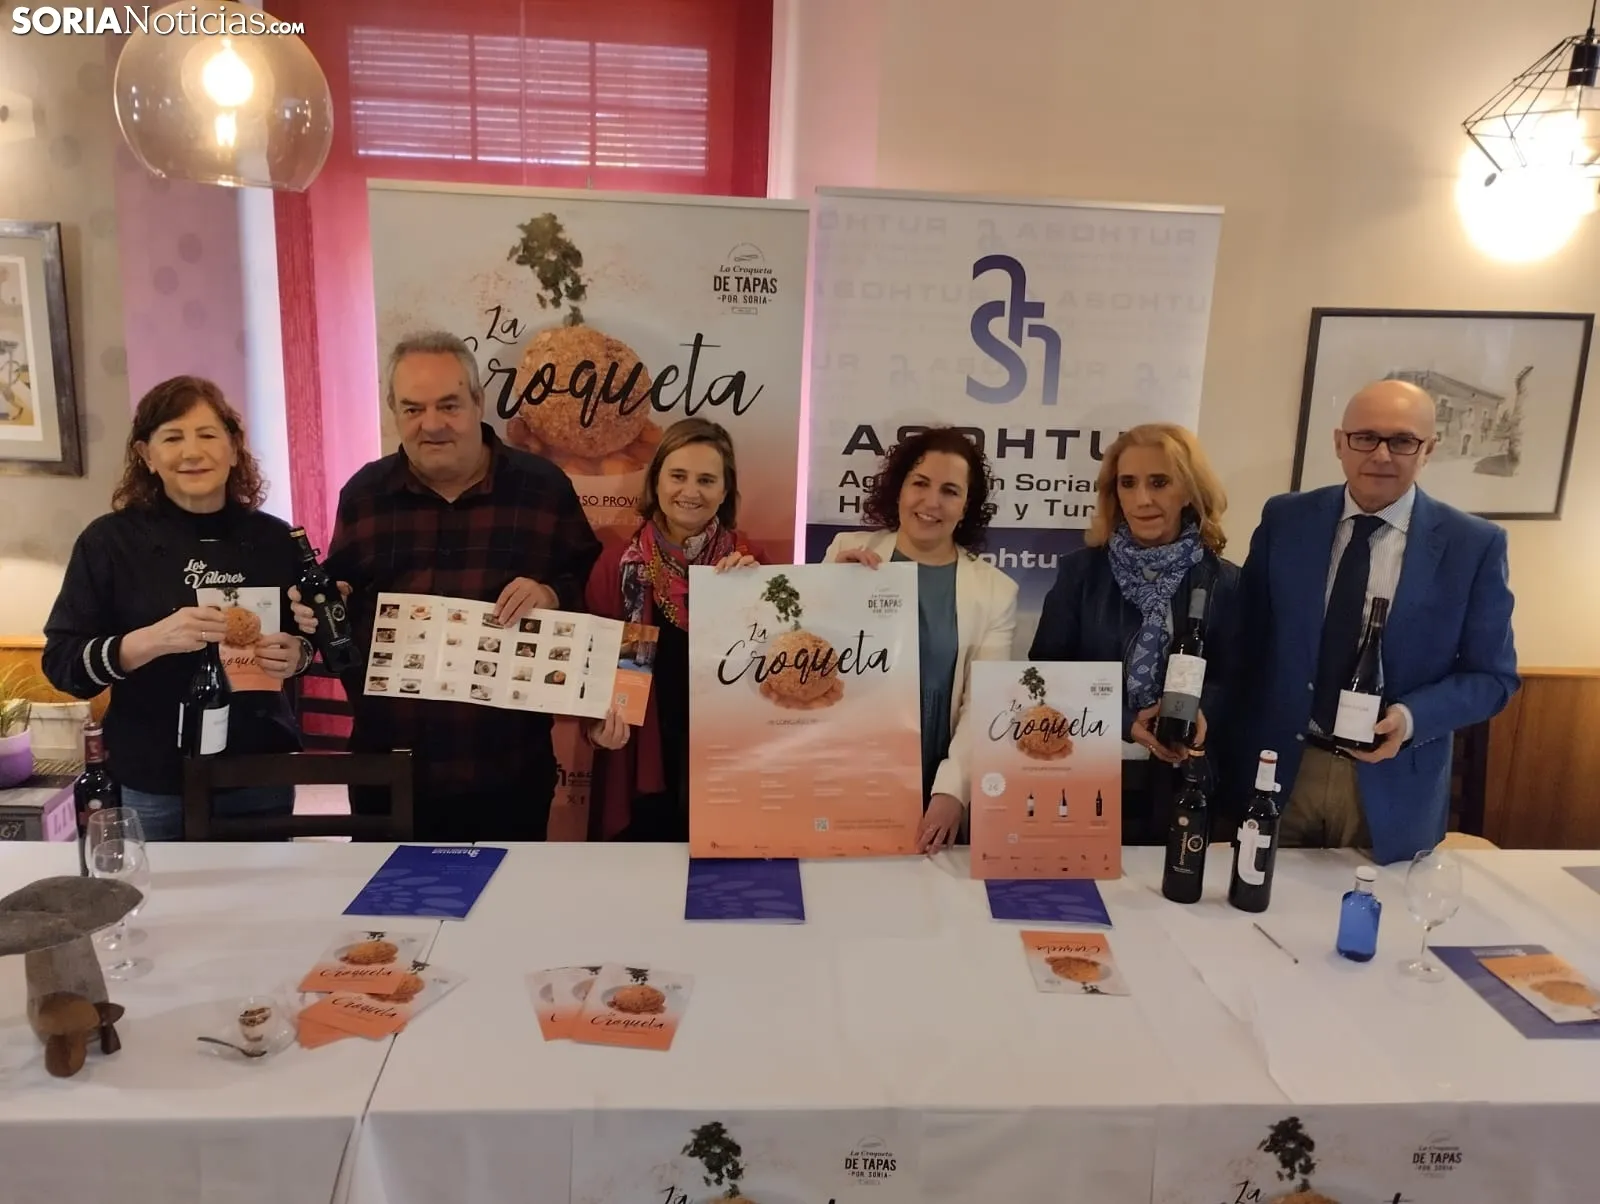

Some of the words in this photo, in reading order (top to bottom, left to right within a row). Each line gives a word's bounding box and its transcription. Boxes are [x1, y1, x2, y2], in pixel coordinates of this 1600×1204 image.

[713, 275, 730, 291] DE
[735, 276, 777, 294] TAPAS
[485, 305, 526, 344] La
[463, 333, 764, 428] roqueta
[880, 598, 904, 609] TAPAS
[748, 622, 769, 643] La
[717, 629, 890, 685] Croqueta
[988, 707, 1111, 742] Croqueta
[320, 967, 393, 978] Croqueta
[331, 997, 398, 1018] Croqueta
[590, 1014, 665, 1030] Croqueta
[845, 1158, 859, 1170] DE
[862, 1158, 897, 1171] TAPAS
[1412, 1152, 1426, 1164] DE
[1430, 1152, 1463, 1164] TAPAS
